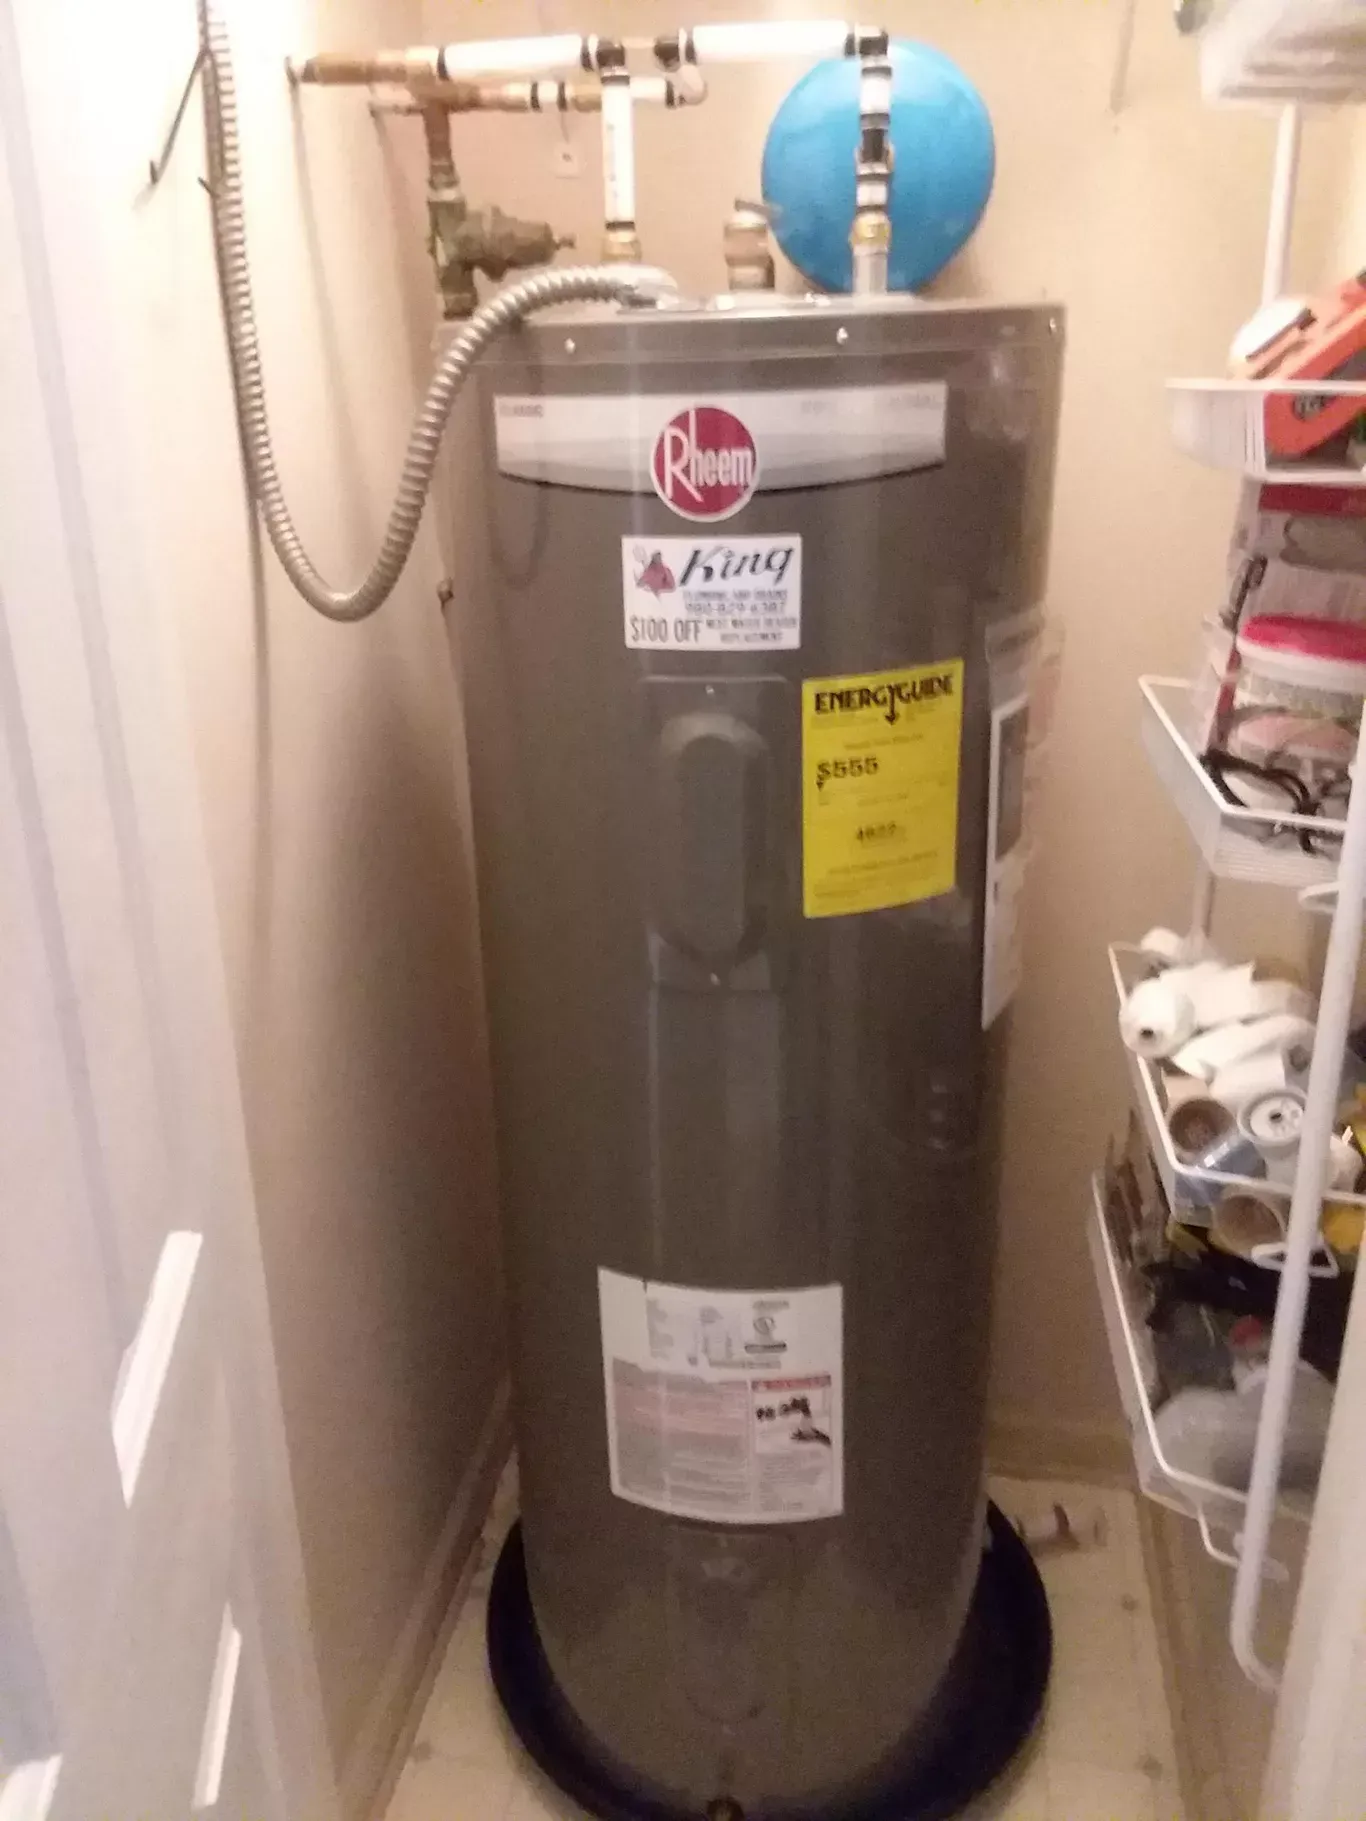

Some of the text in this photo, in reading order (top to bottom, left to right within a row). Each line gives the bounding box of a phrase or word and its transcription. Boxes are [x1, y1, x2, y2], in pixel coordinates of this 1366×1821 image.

[664, 409, 752, 502] Rheem
[679, 544, 795, 587] King
[630, 614, 668, 643] $100
[674, 616, 703, 643] OFF
[814, 673, 954, 715] ENERGYGUIDE
[816, 757, 880, 780] $555
